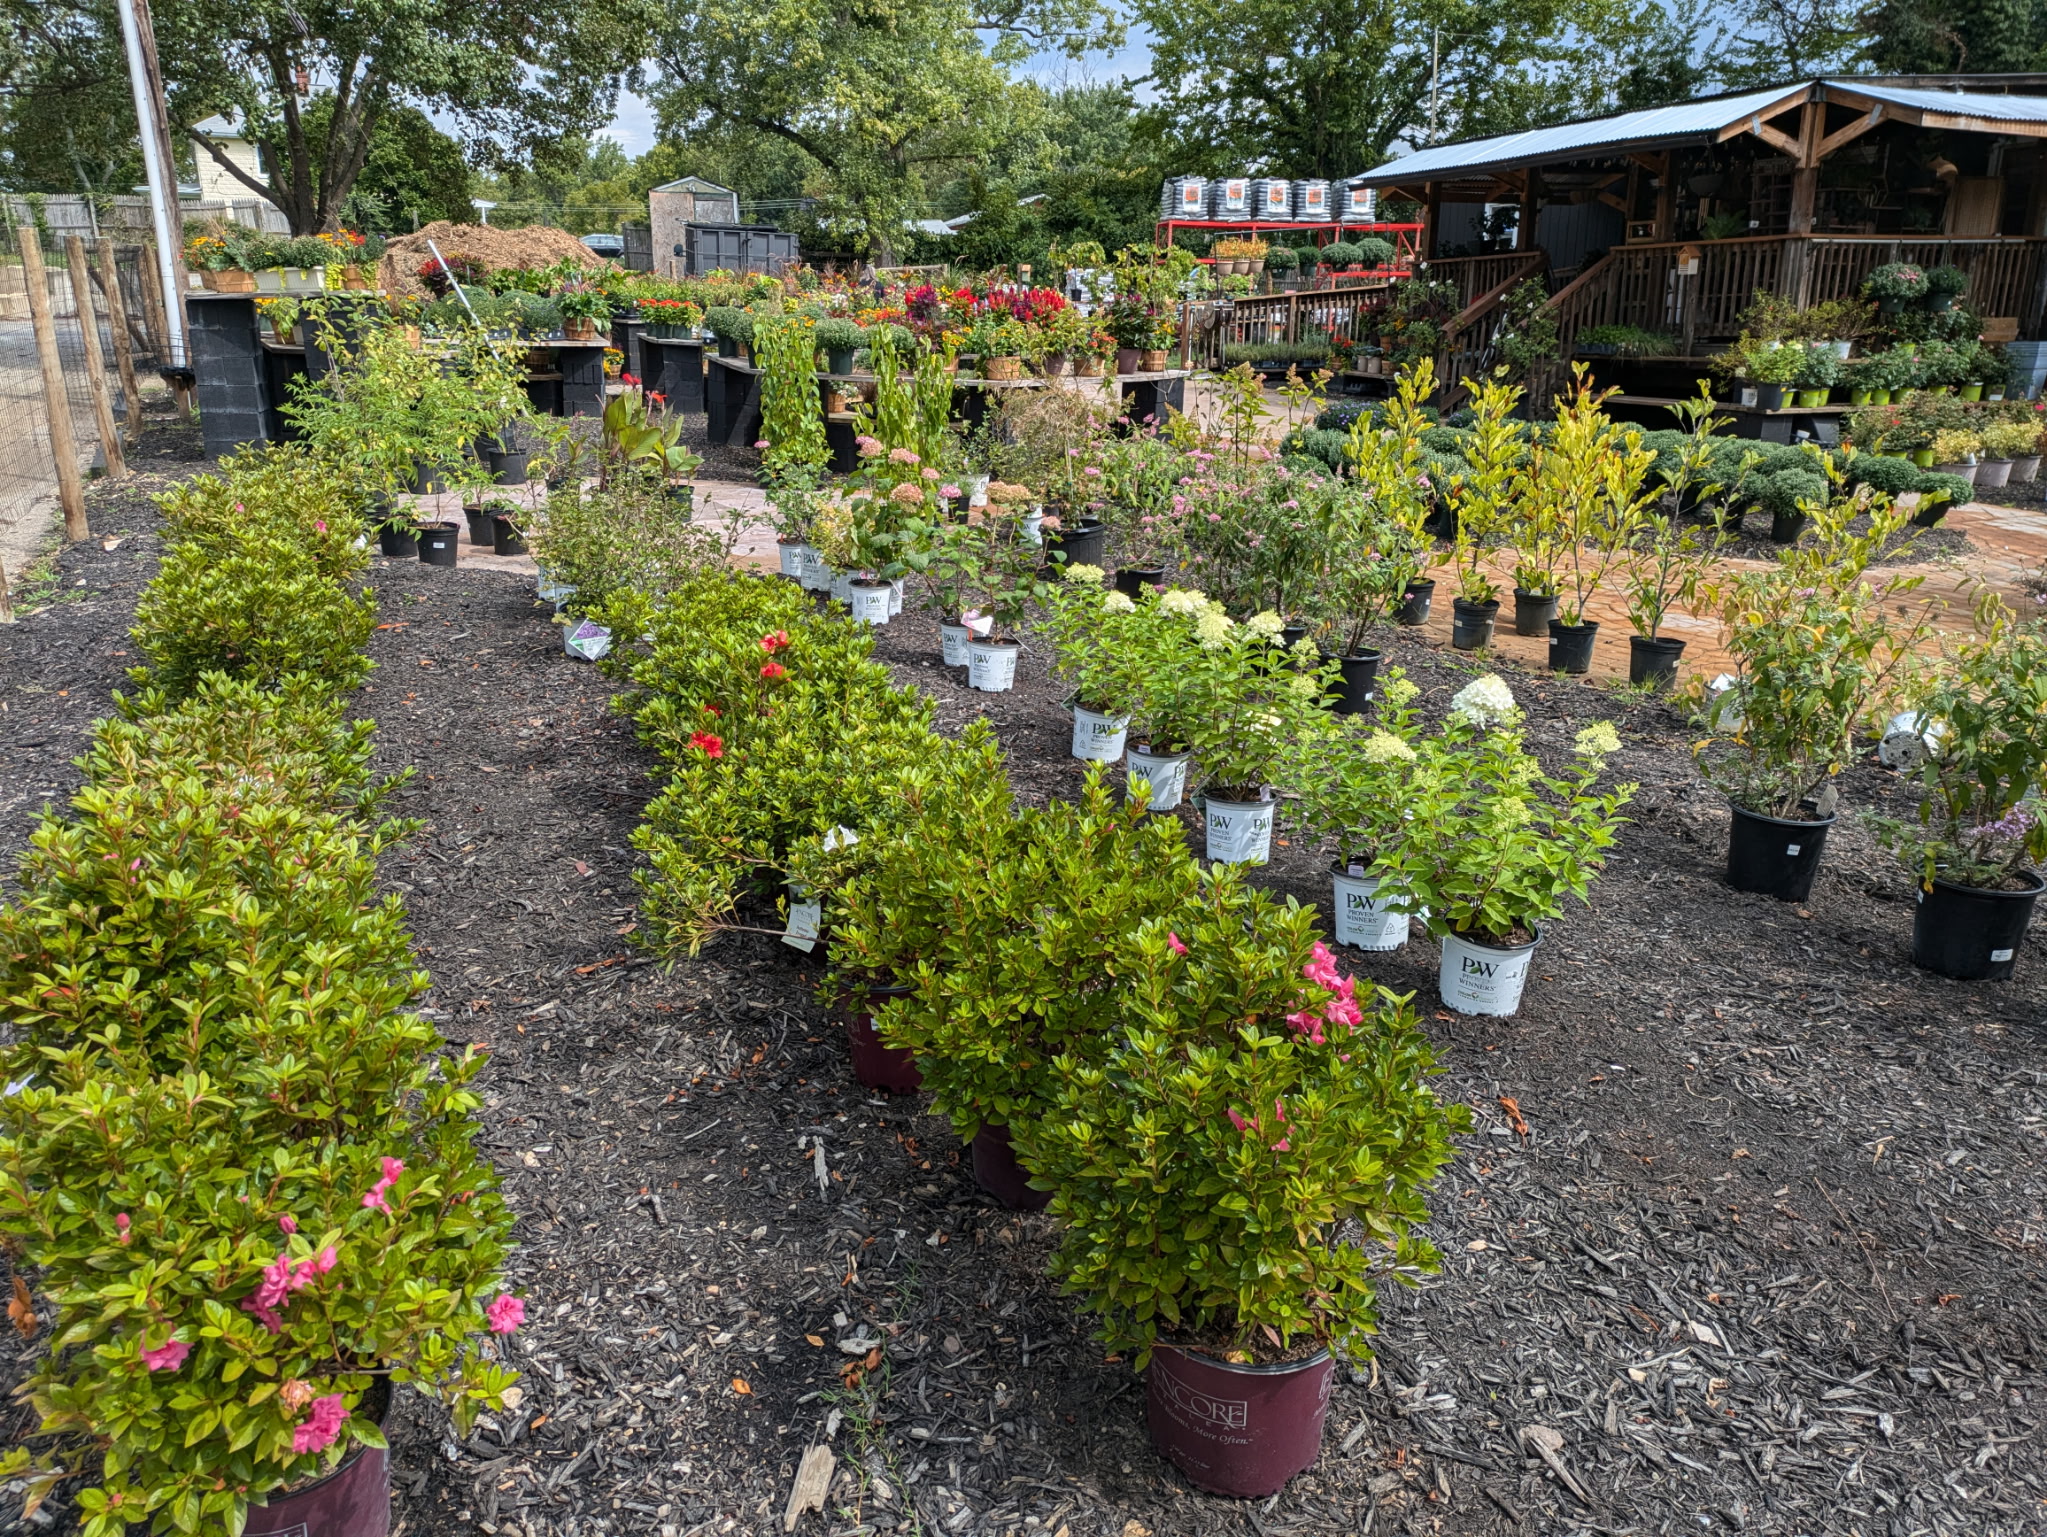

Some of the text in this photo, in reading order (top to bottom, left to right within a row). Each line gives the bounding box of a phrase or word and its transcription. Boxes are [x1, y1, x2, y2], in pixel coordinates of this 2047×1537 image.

[1210, 813, 1232, 830] PW
[1346, 892, 1377, 911] PW
[1347, 914, 1378, 924] WINNERS
[1348, 909, 1375, 918] PROVEN
[1462, 955, 1500, 979] PW
[1459, 977, 1496, 992] WINNERS
[1192, 1425, 1217, 1441] More
